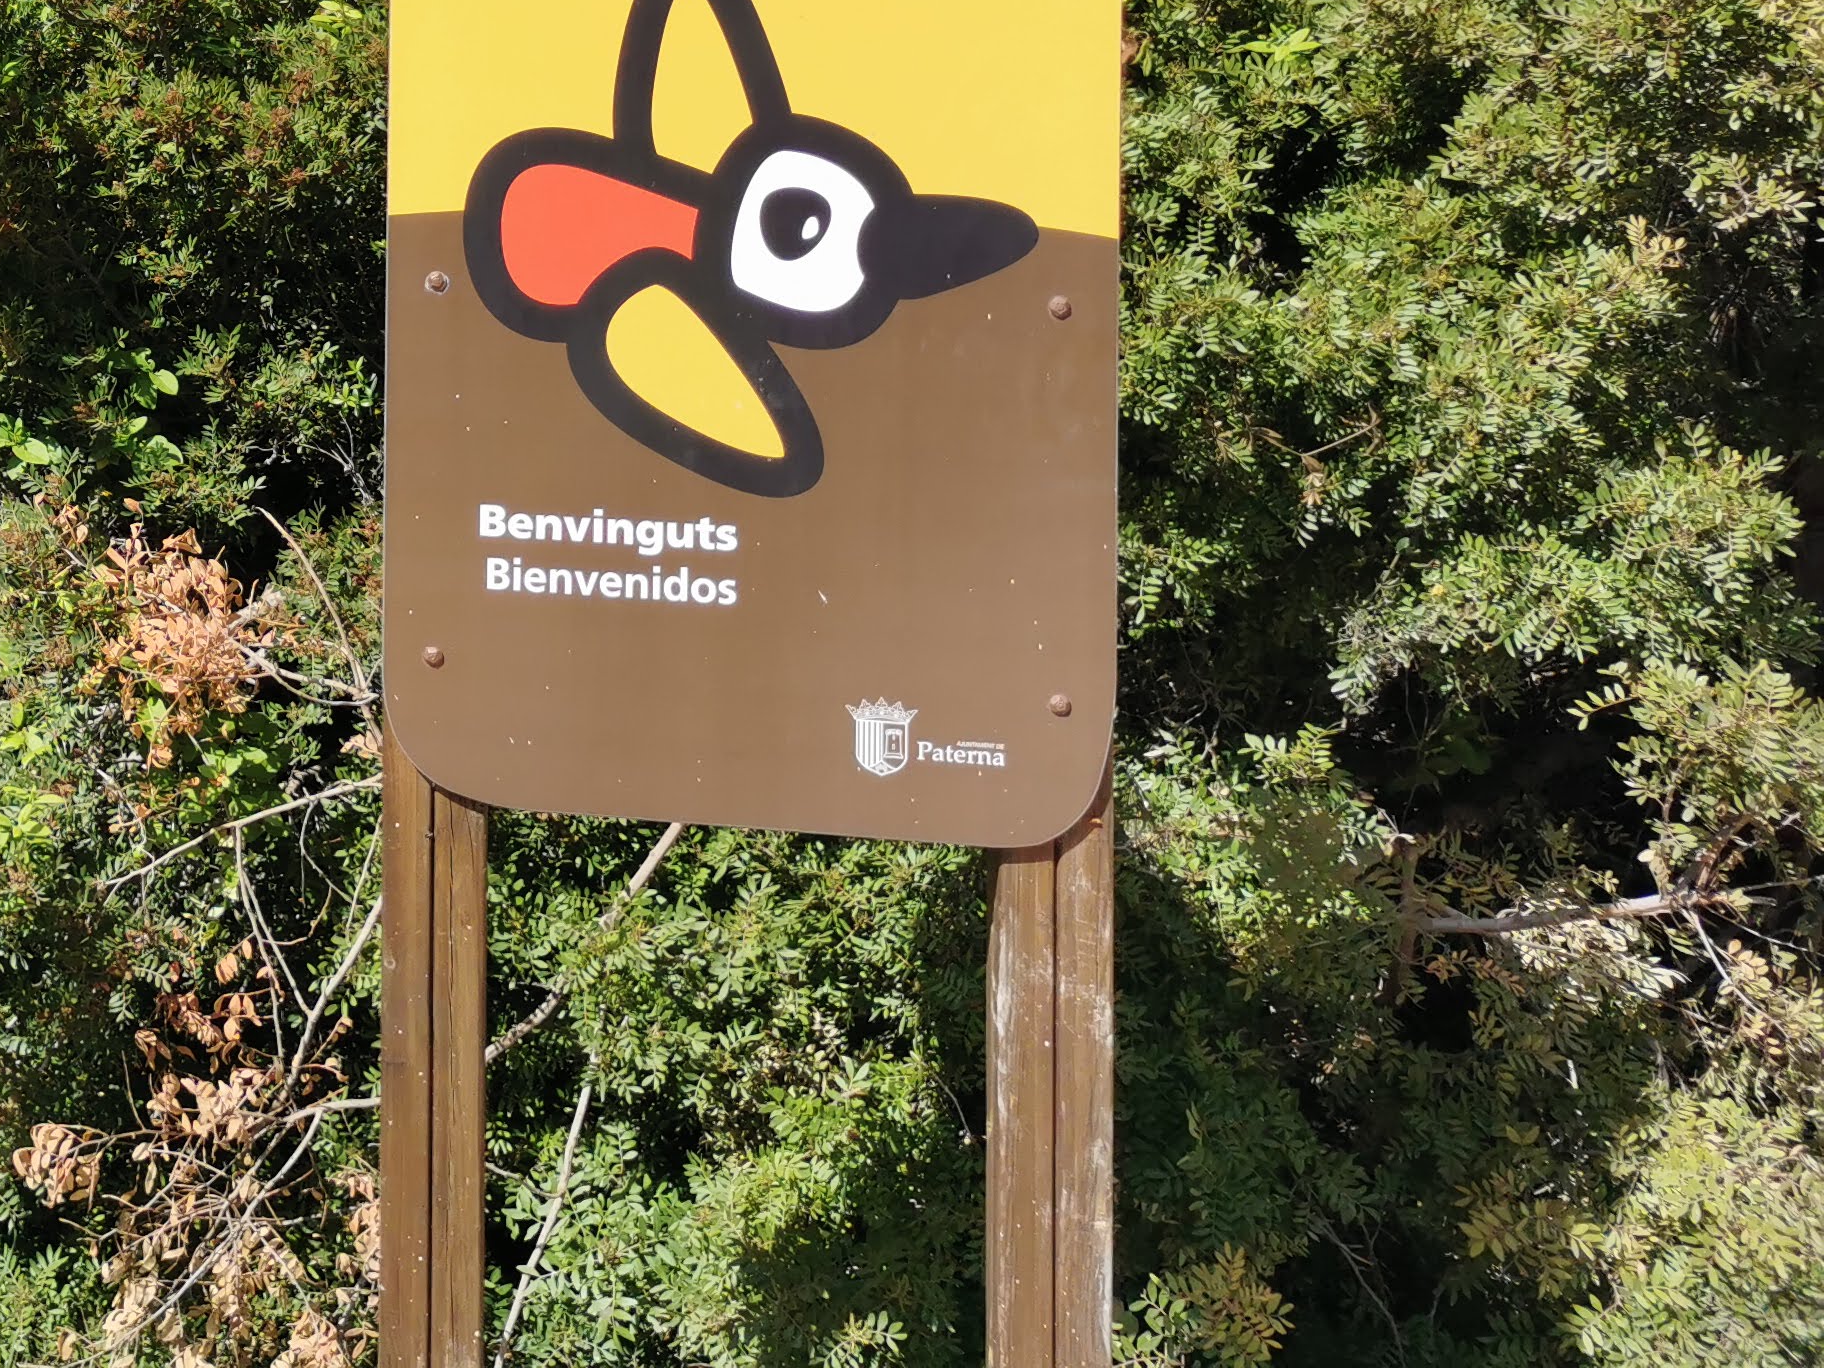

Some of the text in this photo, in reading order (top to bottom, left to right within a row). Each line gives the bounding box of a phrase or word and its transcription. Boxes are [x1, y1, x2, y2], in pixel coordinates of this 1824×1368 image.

[479, 503, 738, 556] Benvinguts
[486, 557, 737, 606] Bienvenidos
[917, 741, 1005, 767] Paterna
